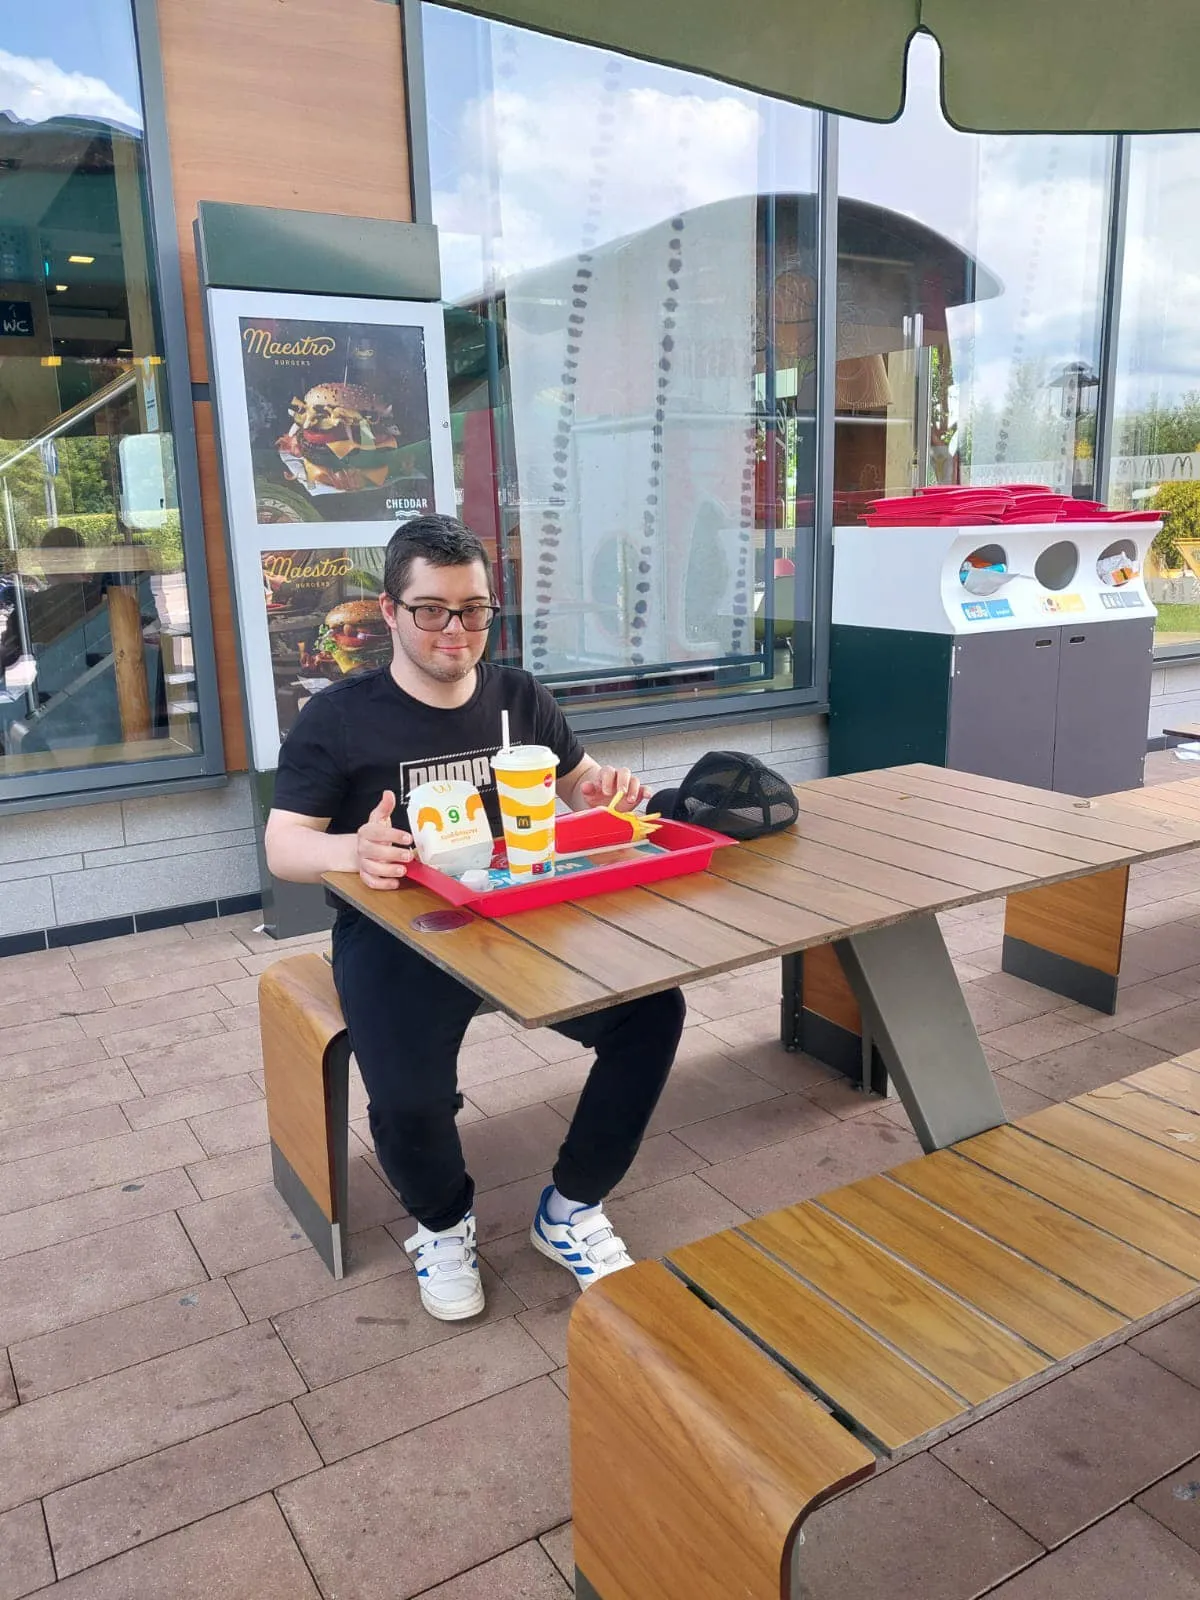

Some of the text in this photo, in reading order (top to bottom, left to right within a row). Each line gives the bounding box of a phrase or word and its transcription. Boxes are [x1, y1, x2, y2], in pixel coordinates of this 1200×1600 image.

[3, 319, 29, 332] WC
[243, 328, 335, 359] Maestro
[274, 359, 311, 367] BURGERS
[385, 498, 428, 510] CHEDDAR
[264, 556, 354, 582] Maestro
[448, 809, 460, 823] 9
